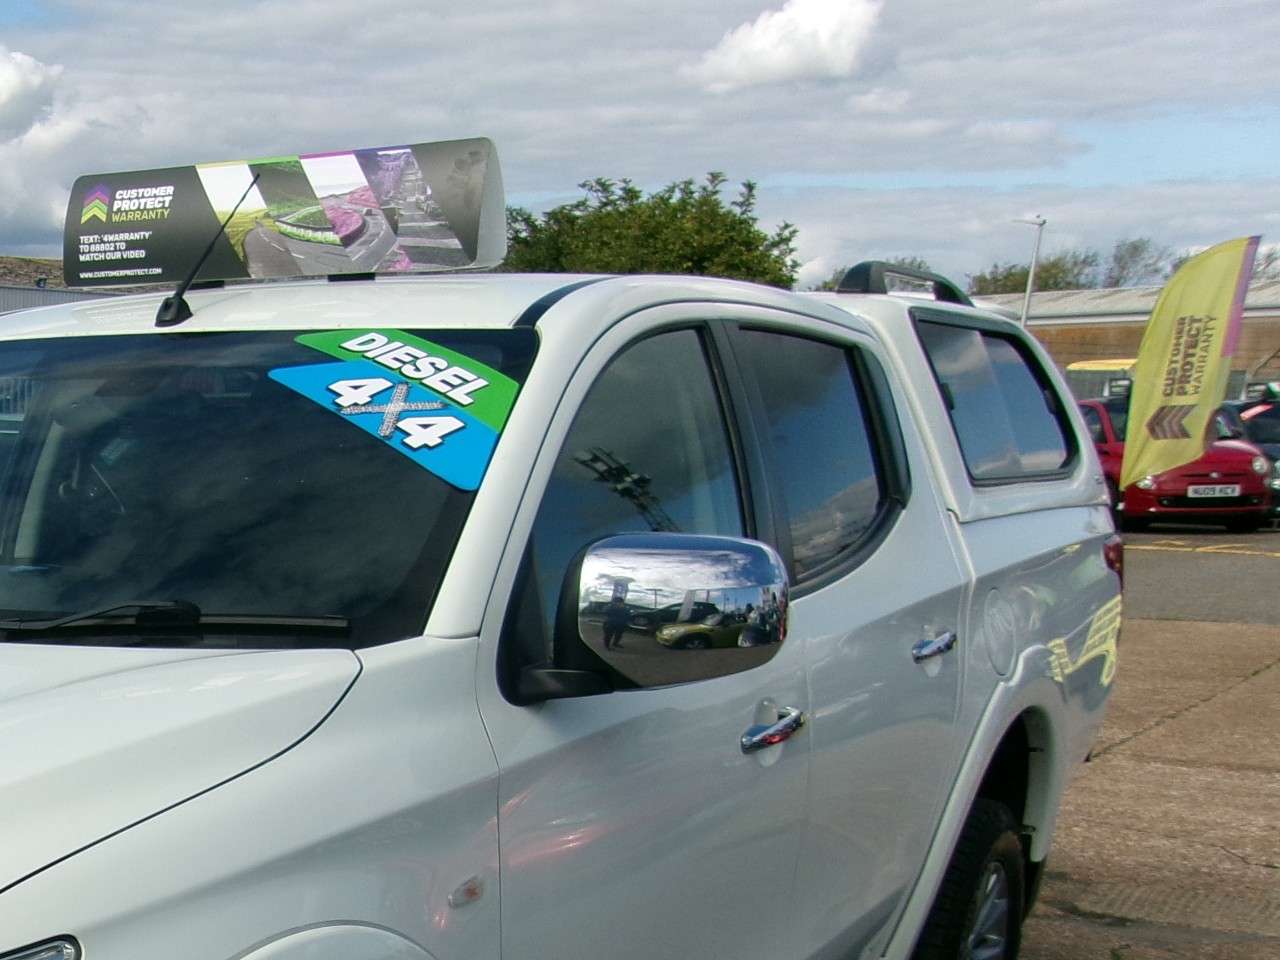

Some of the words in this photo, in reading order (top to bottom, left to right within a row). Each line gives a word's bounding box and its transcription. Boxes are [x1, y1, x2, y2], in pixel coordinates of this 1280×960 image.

[115, 186, 174, 199] CUSTOMER
[113, 196, 173, 211] PROTECT
[112, 208, 170, 222] WARRANTY
[79, 245, 89, 253] TO
[116, 242, 126, 250] TO
[106, 251, 122, 259] OUR
[122, 250, 146, 259] VIDEO
[1163, 317, 1187, 397] CUSTOMER
[1175, 316, 1202, 396] PROTECT
[1189, 314, 1217, 395] WARRANTY
[339, 332, 489, 406] DIESEL
